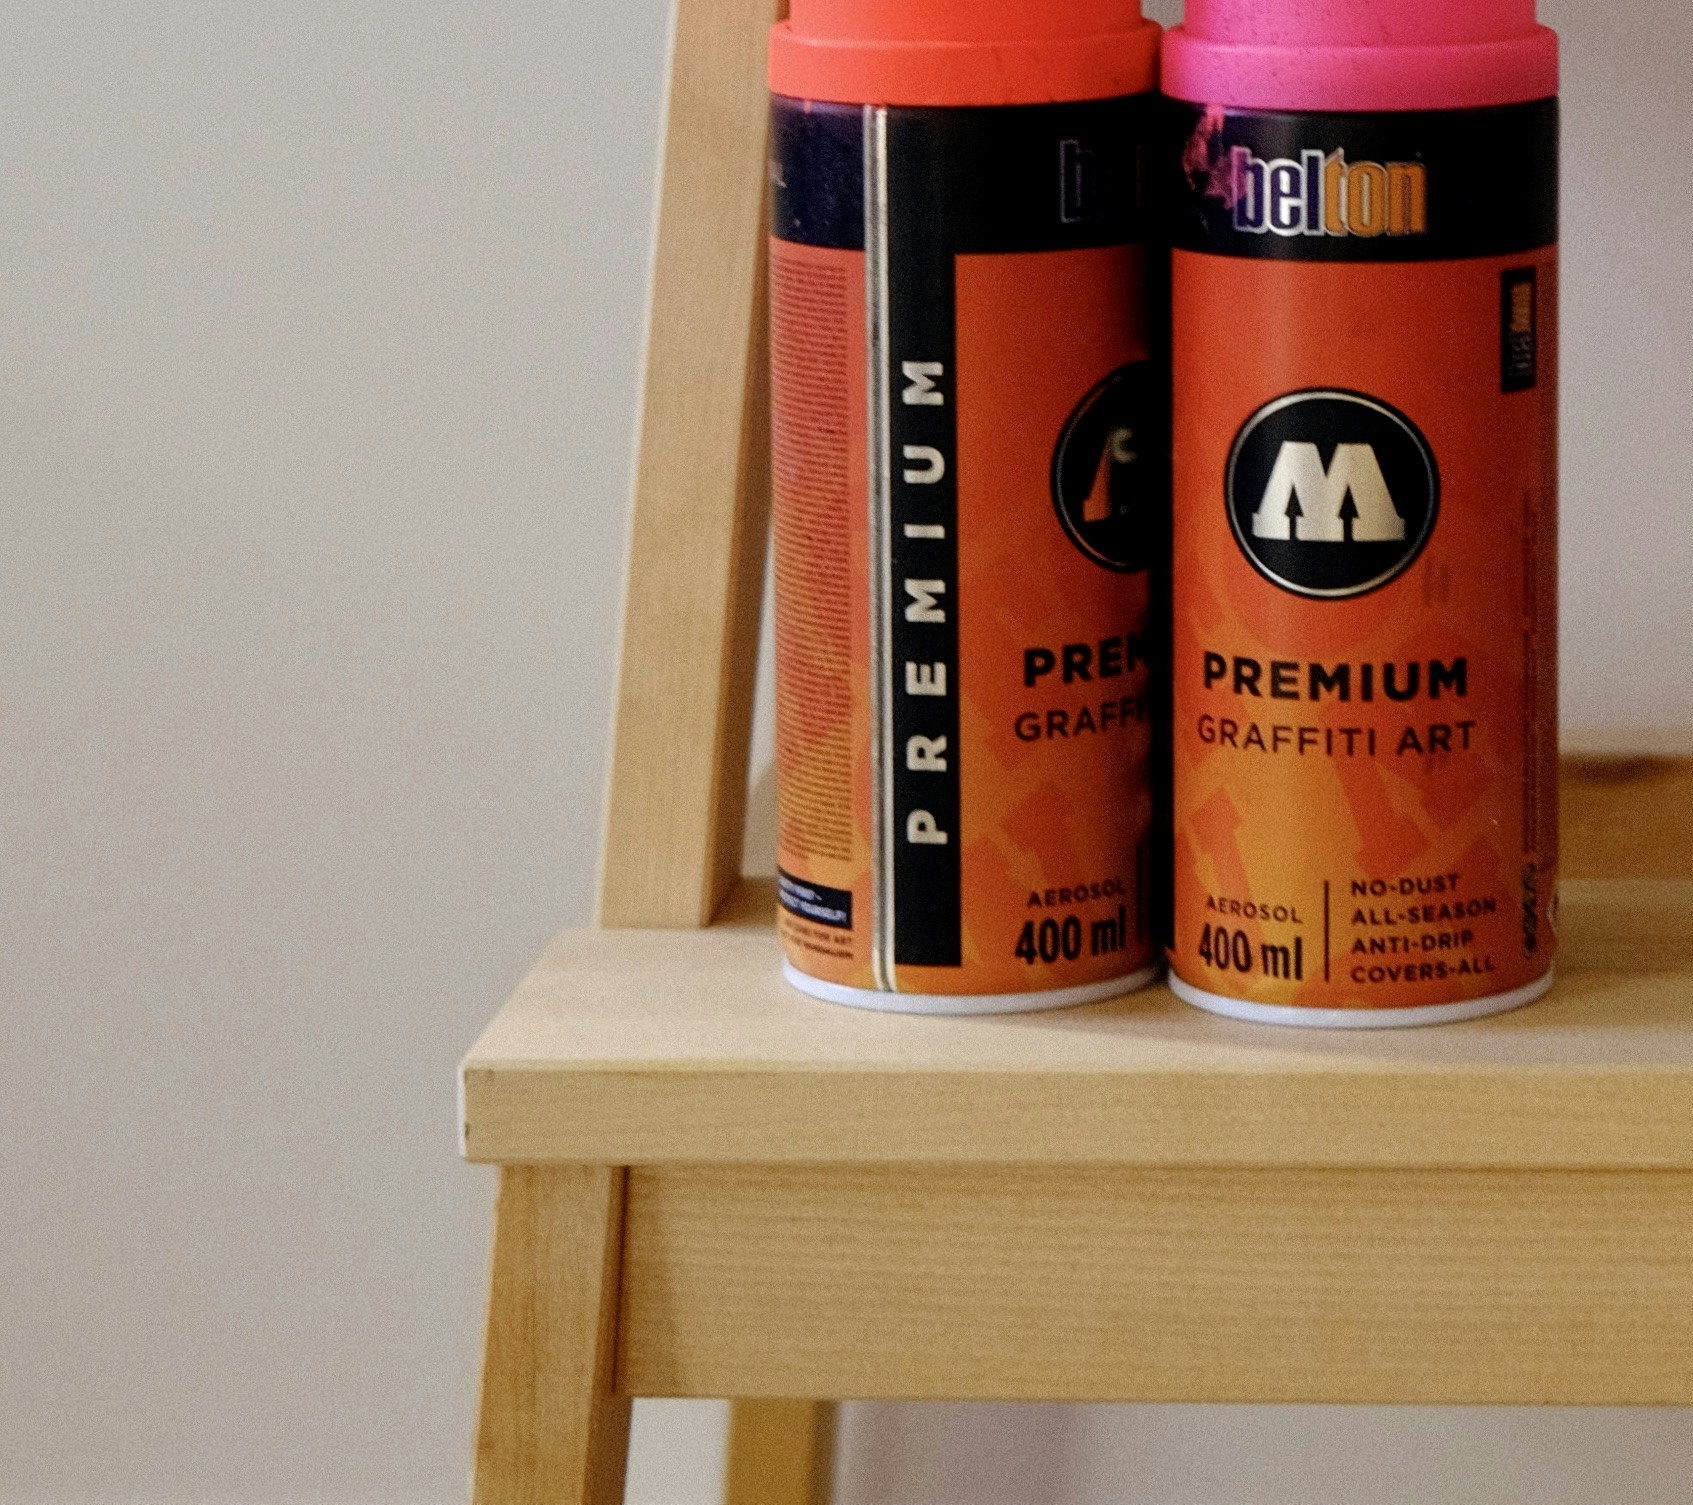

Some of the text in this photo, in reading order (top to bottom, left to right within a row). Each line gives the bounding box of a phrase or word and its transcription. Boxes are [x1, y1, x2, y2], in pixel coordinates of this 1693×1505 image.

[1231, 145, 1427, 238] belton
[1251, 441, 1406, 542] M
[901, 360, 948, 845] PREMIUM
[1203, 651, 1468, 702] PREMIUM
[1014, 695, 1145, 742] GRAFFI
[1197, 713, 1476, 757] GRAFFITI ART
[1027, 878, 1123, 908] AEROSOL
[1351, 873, 1460, 897] NO-DUST
[1206, 895, 1304, 924] AEROSOL
[1351, 897, 1497, 926] ALL-SEASON
[1014, 903, 1126, 965] 400 ml
[1199, 922, 1304, 981] 400 ml
[1351, 929, 1474, 955] ANTI-DRIP
[1351, 955, 1496, 983] COVERS-ALL
